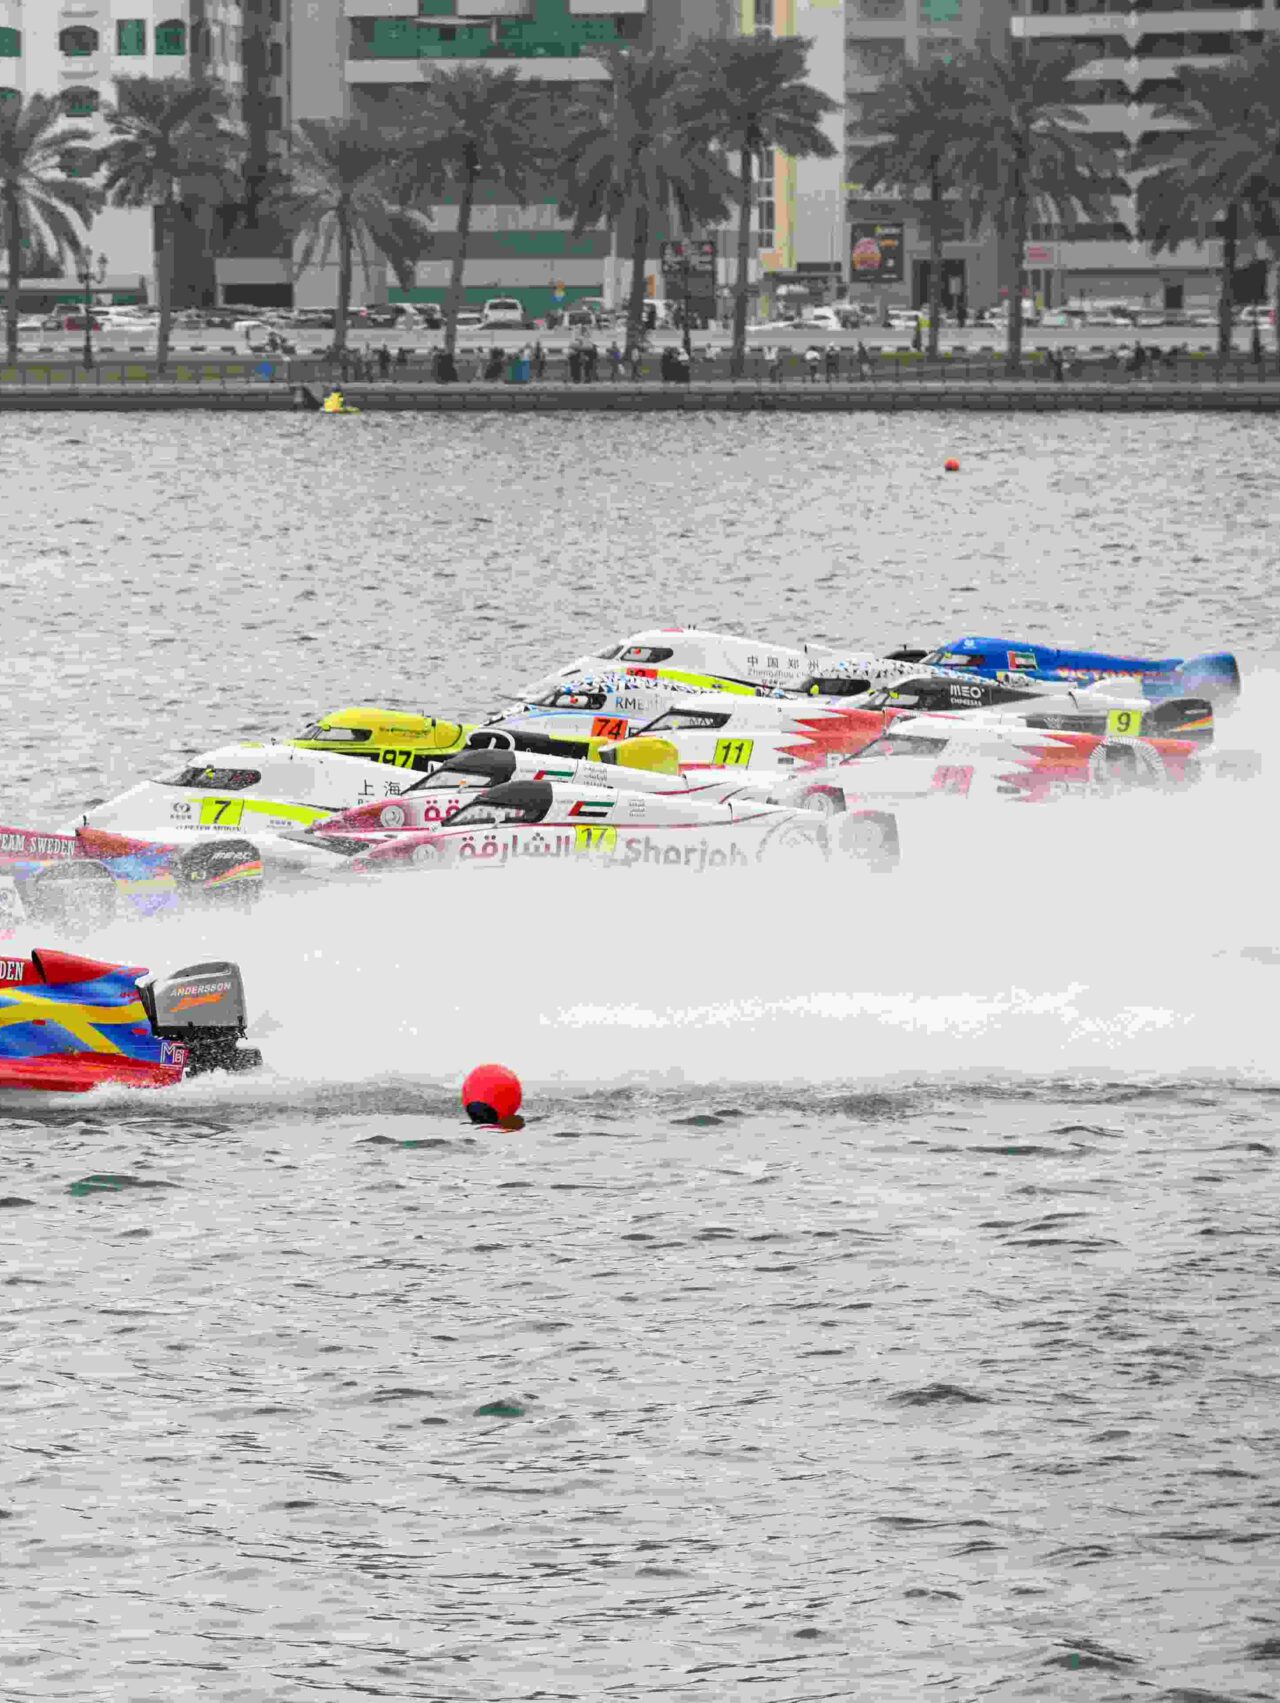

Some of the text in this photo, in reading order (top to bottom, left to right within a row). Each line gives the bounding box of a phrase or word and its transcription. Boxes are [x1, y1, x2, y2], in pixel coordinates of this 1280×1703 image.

[596, 719, 622, 740] 74
[1117, 712, 1131, 733] 9
[382, 750, 412, 768] 97
[721, 742, 745, 764] 11
[214, 800, 232, 824] 7
[30, 838, 75, 855] SWEDEN
[580, 827, 609, 848] 17
[170, 981, 232, 997] ANDERSSON
